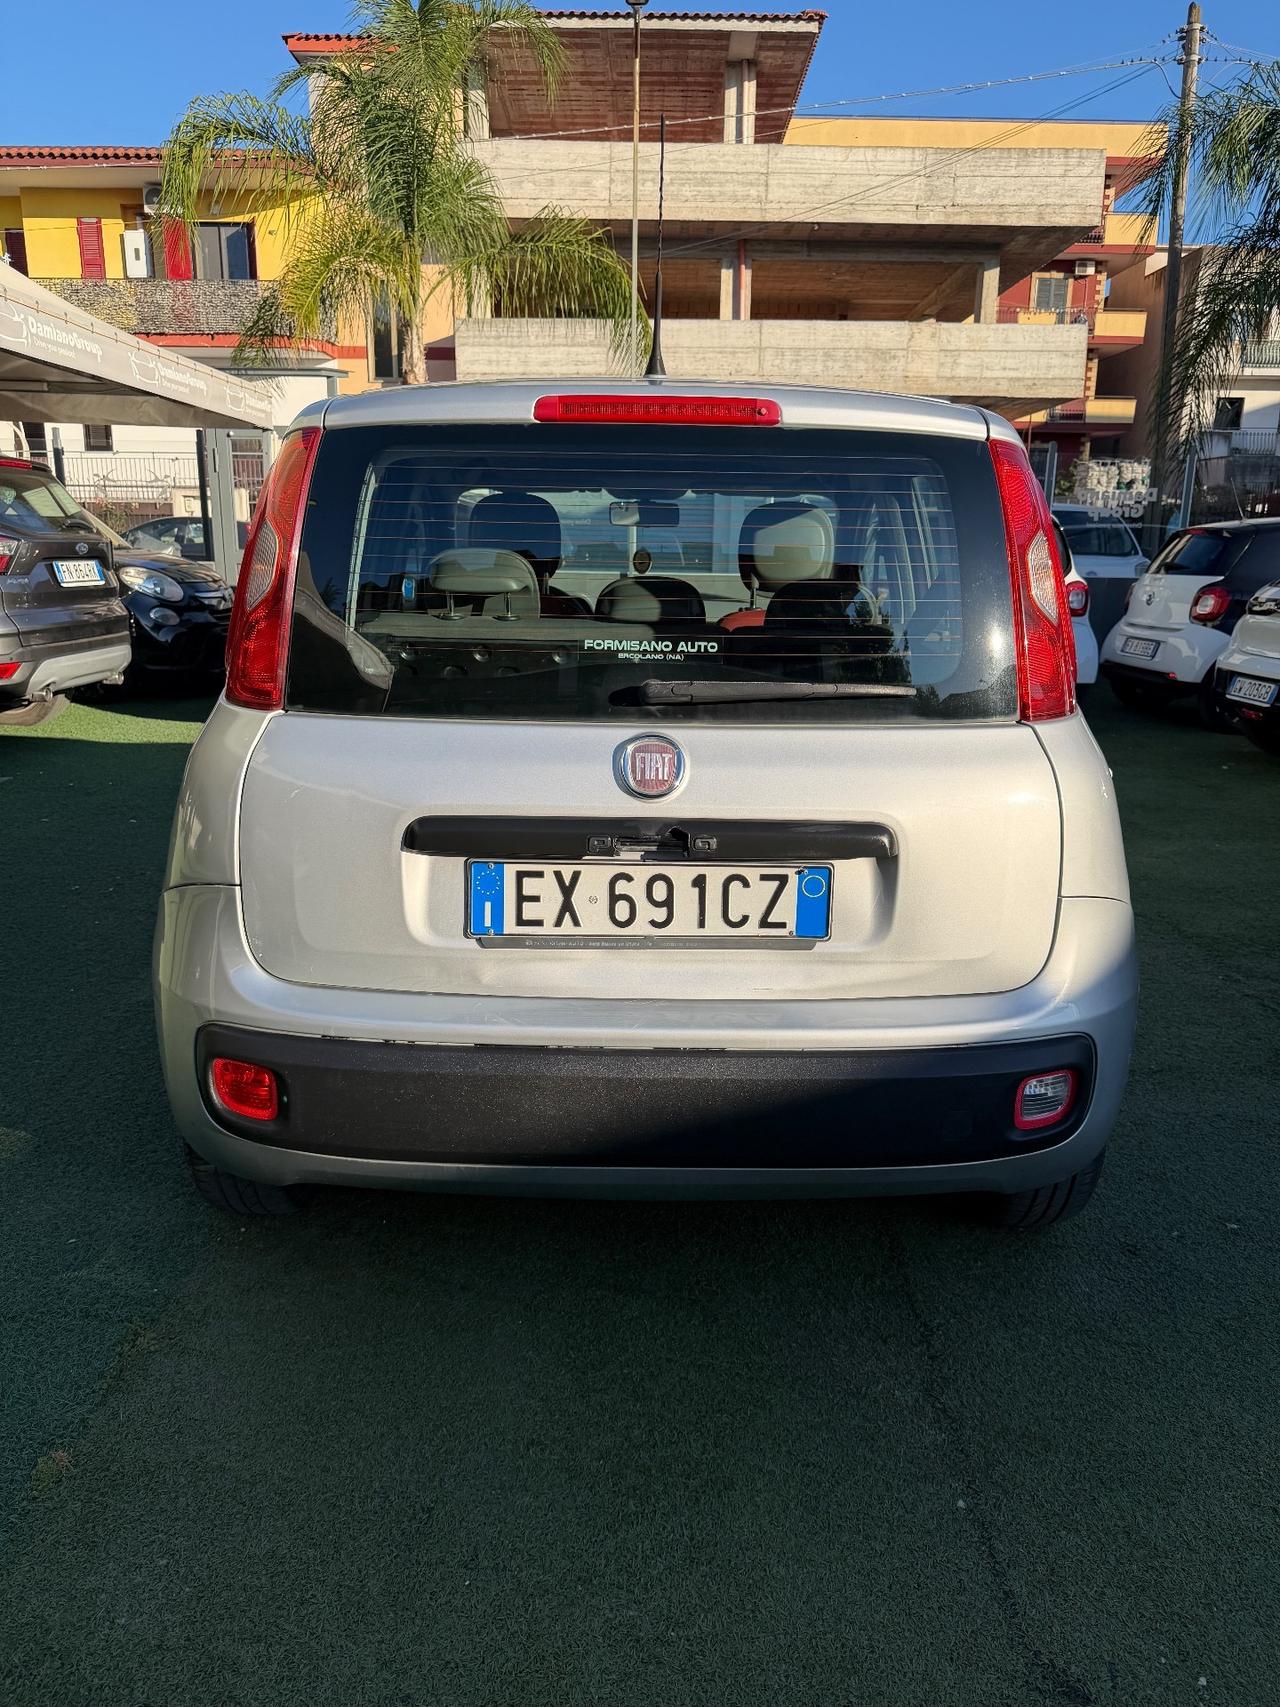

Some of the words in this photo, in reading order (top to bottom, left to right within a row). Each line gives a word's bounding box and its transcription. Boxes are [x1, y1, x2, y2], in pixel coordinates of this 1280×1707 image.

[28, 315, 103, 363] DamianoGroup
[584, 639, 673, 652] FORMISANO
[676, 641, 718, 653] AUTO
[666, 653, 684, 661] (NA)
[635, 752, 673, 781] FIAT
[514, 869, 582, 928] EX
[607, 871, 790, 929] 691CZ
